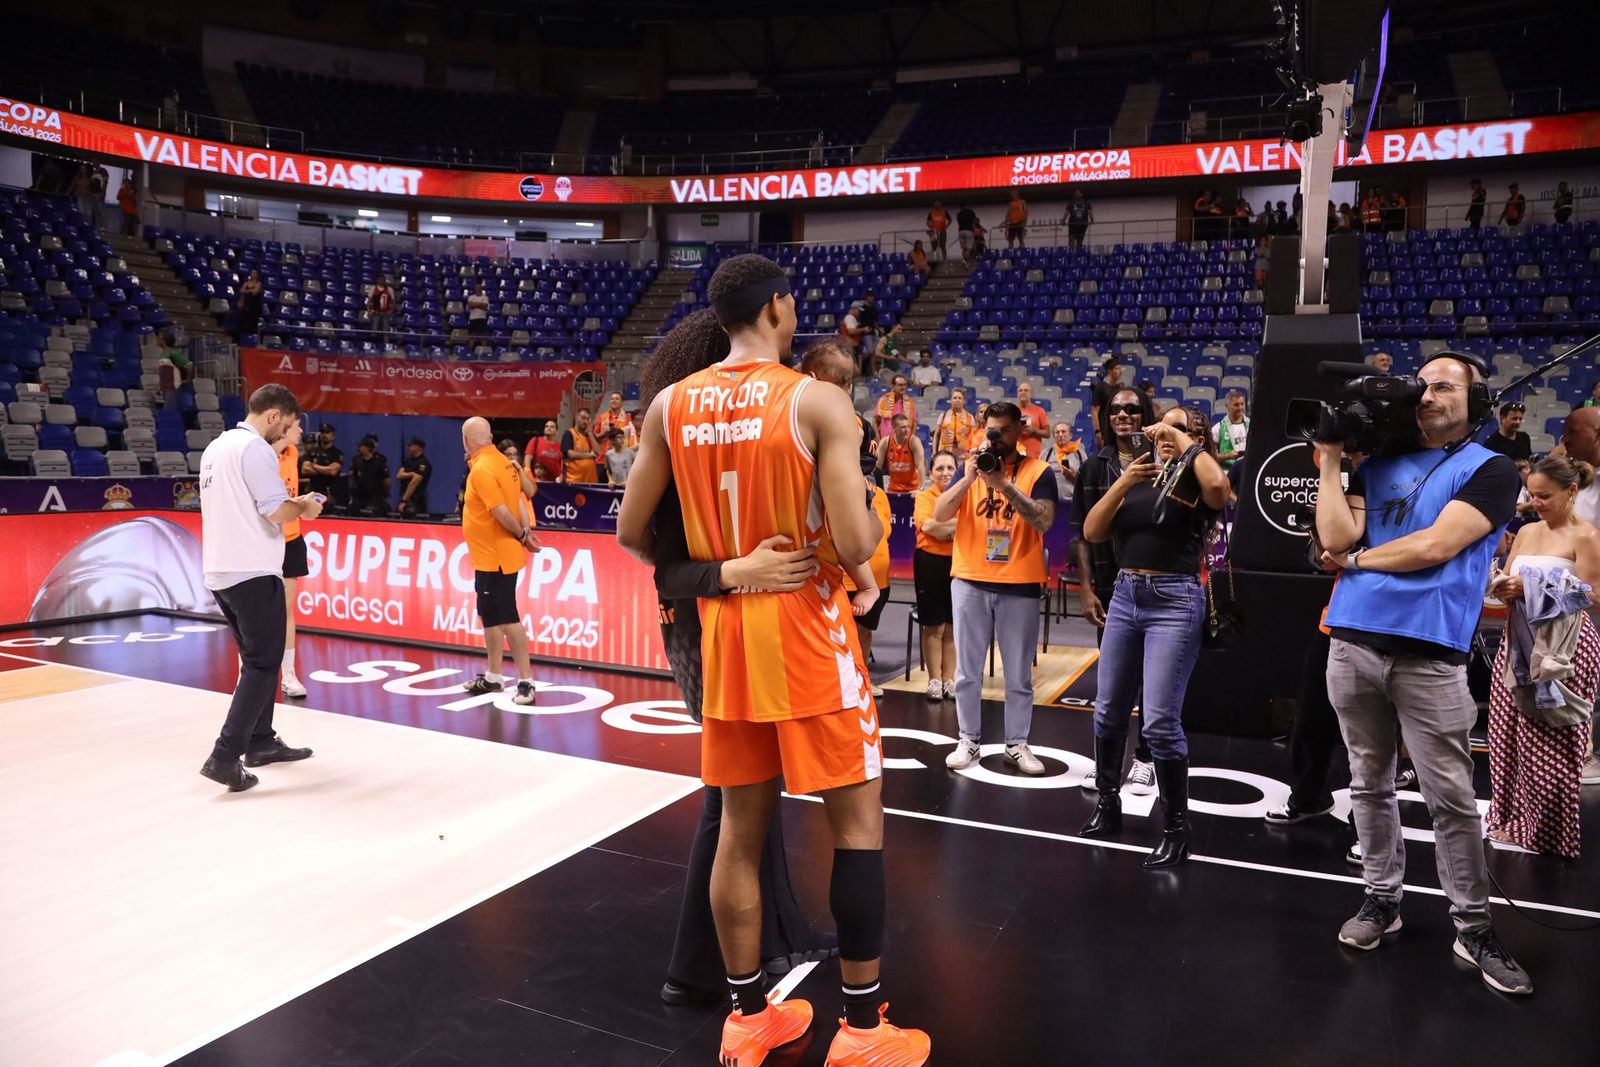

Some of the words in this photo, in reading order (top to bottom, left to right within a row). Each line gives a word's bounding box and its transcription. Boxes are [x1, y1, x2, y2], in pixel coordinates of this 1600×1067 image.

[36, 129, 62, 143] 2025
[1196, 139, 1373, 175] VALENIA
[1382, 121, 1533, 162] BASKET
[134, 131, 300, 183] VALENCIA
[308, 160, 423, 195] BASKET
[1011, 171, 1058, 185] endesa
[1069, 170, 1108, 182] MÁLAGA
[1109, 168, 1131, 180] 2025
[1012, 150, 1131, 173] SUPERCOPA
[670, 173, 808, 203] VALENCIA
[814, 166, 921, 197] BASKET
[670, 248, 702, 262] SALIDA
[386, 365, 443, 380] endesa
[539, 368, 568, 379] pelayo
[687, 380, 769, 414] TAYLOR
[682, 417, 763, 447] PAMESA
[544, 502, 578, 520] acb
[720, 470, 740, 558] 1
[302, 530, 598, 604] SUPERCPA
[297, 587, 403, 626] endesa
[0, 631, 185, 647] acb
[432, 599, 535, 642] MÁLA
[537, 614, 599, 649] 2025
